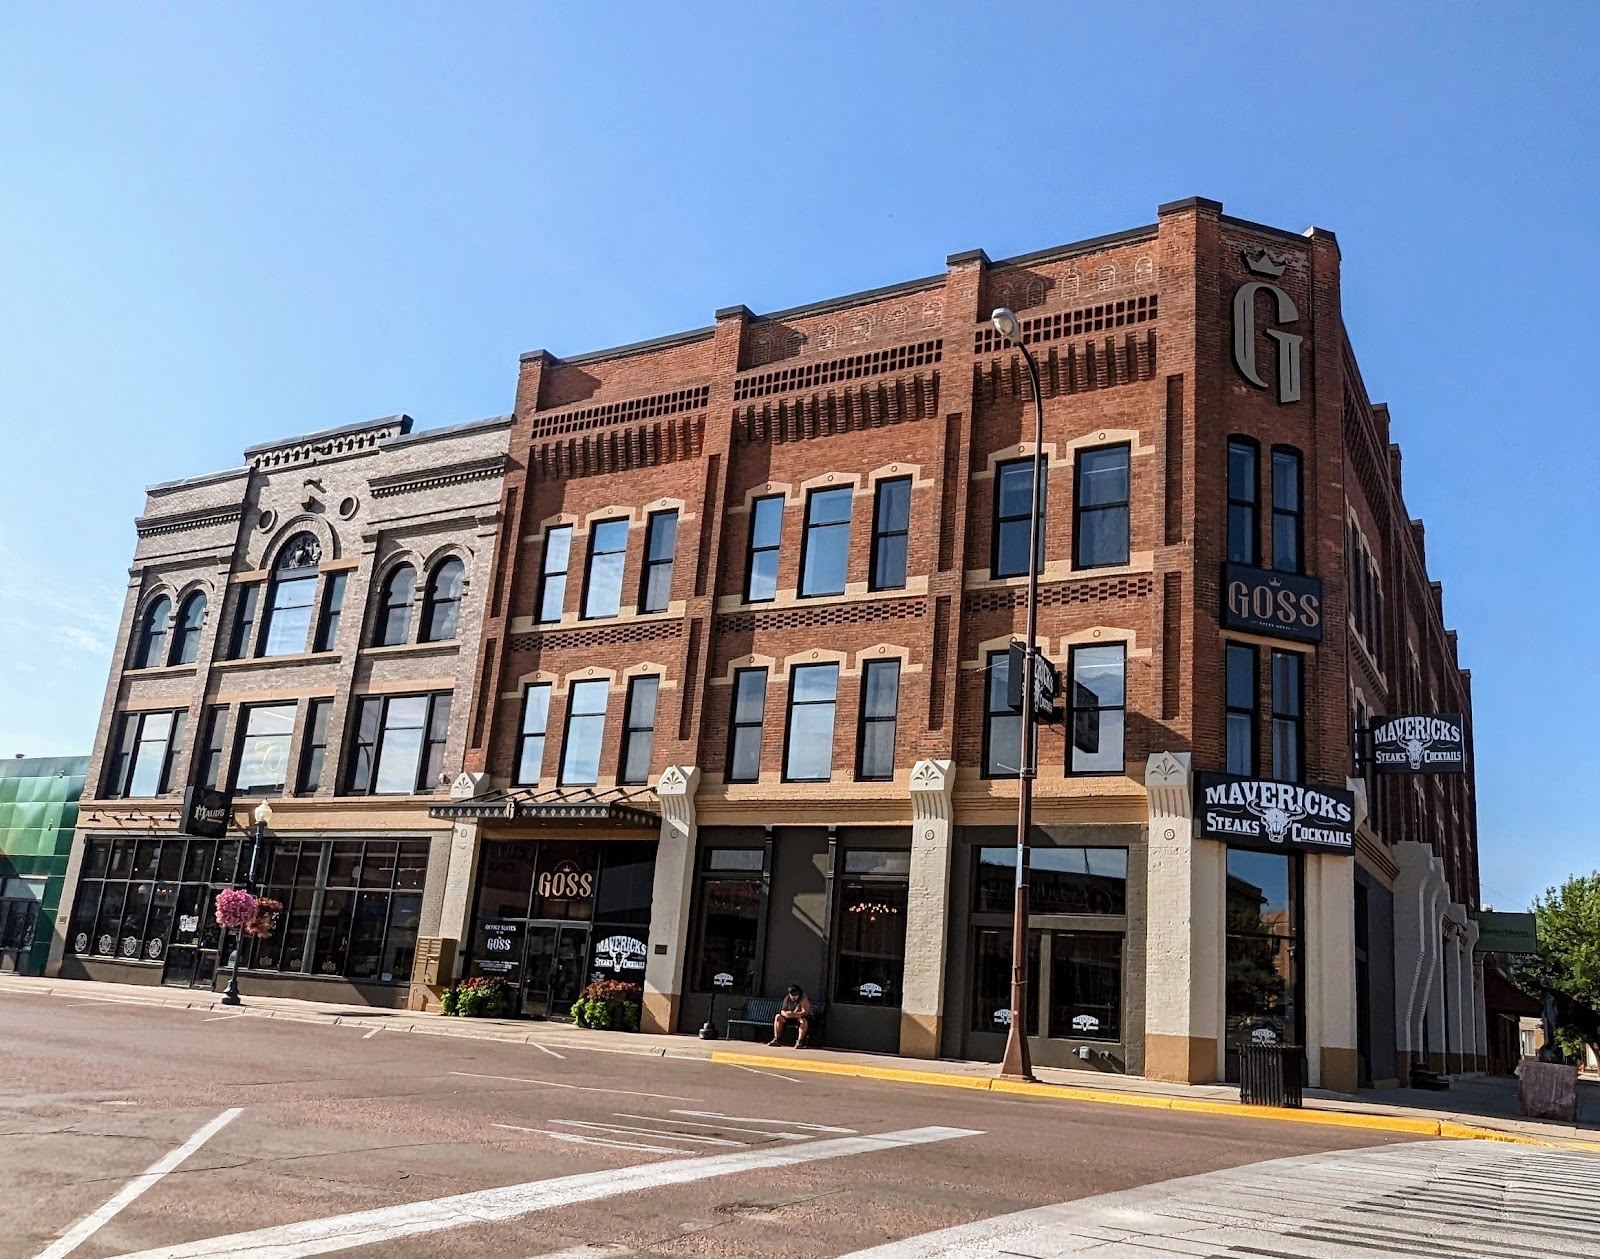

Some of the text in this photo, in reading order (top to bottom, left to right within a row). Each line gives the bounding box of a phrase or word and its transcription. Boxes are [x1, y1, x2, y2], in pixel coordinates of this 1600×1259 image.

[1234, 282, 1303, 403] G
[1228, 581, 1319, 627] GOSS
[1374, 716, 1461, 745] MAVERICKS
[1375, 750, 1462, 764] STEAKS COCKTAILS
[1205, 782, 1351, 822] MAVERICKS
[1206, 812, 1352, 845] STEAKS COCKTAILS
[538, 872, 593, 898] GOSS
[487, 938, 512, 951] GOSS
[596, 936, 647, 955] MAVERICKS
